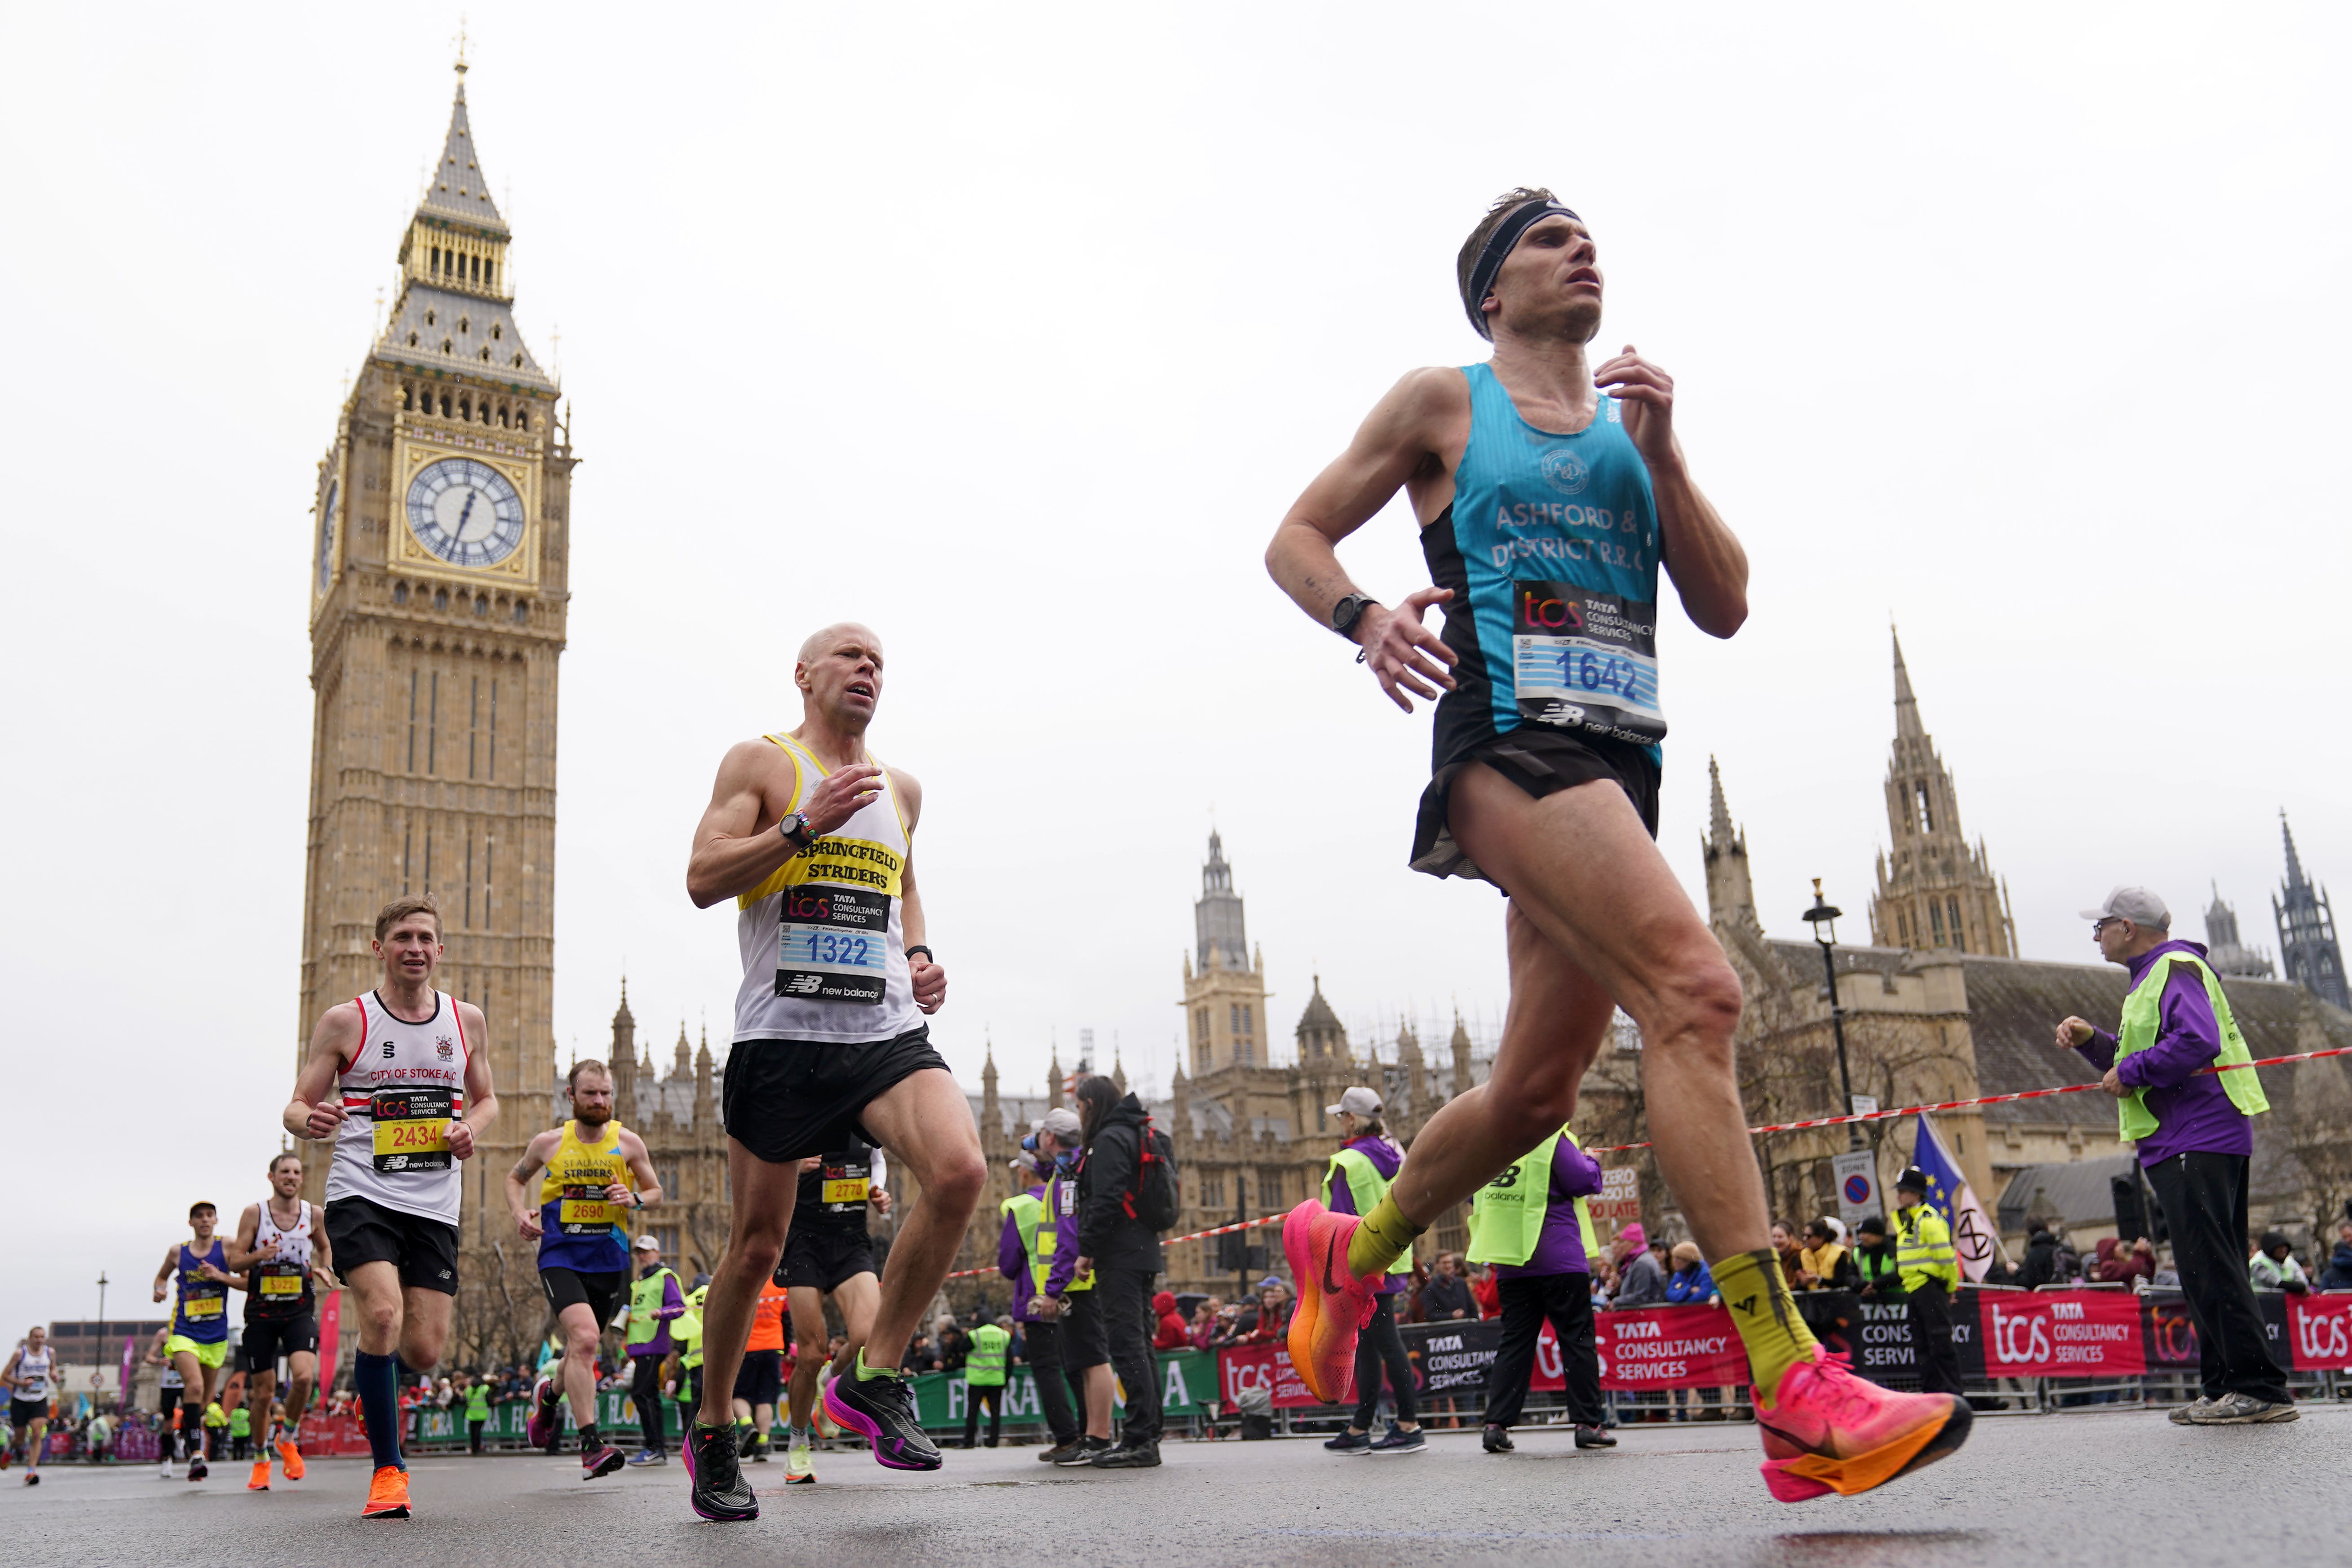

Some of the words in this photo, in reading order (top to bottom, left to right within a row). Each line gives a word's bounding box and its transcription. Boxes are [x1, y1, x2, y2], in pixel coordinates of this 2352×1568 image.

[1497, 503, 1613, 530] ASHFORD
[1621, 510, 1638, 534] &
[1492, 538, 1594, 567] DISTRICT
[1524, 591, 1583, 628] tcs
[1585, 599, 1617, 614] TATA
[1557, 651, 1637, 700] 1642
[1584, 722, 1612, 734] new
[1611, 726, 1653, 744] balance
[797, 842, 897, 871] SPRINGFIELD
[808, 864, 888, 889] STRIDERS
[788, 896, 828, 918] tcs
[833, 894, 856, 904] TATA
[832, 912, 866, 924] SERVICES
[833, 904, 884, 917] CONSULTANCY
[807, 934, 868, 966] 1322
[822, 987, 842, 996] new
[844, 988, 879, 999] balance
[370, 1069, 392, 1081] CITY
[394, 1069, 407, 1078] OF
[410, 1069, 441, 1078] STOKE
[443, 1071, 456, 1081] A.C.
[376, 1099, 407, 1117] tcs
[393, 1126, 438, 1147] 2434
[564, 1160, 573, 1168] ST
[576, 1159, 613, 1168] ALBANS
[564, 1169, 612, 1178] STRIDERS
[1602, 1167, 1636, 1186] ZERO
[565, 1185, 584, 1198] tcs
[836, 1184, 863, 1197] 2770
[1625, 1184, 1636, 1199] IS
[573, 1205, 603, 1218] 2690
[1608, 1200, 1639, 1218] LATE
[2051, 1302, 2085, 1320] TATA
[1613, 1321, 1661, 1340] TATA
[1992, 1303, 2051, 1364] tcs
[2054, 1324, 2130, 1342] CONSULTANCY
[2297, 1304, 2348, 1358] tcs
[1426, 1335, 1464, 1353] TATA
[1615, 1336, 1727, 1360] CONSULTANCY
[1864, 1347, 1916, 1366] SERVI
[2055, 1345, 2104, 1363] SERVICES
[1616, 1360, 1687, 1380] SERVICES
[1429, 1369, 1484, 1391] SERVICES
